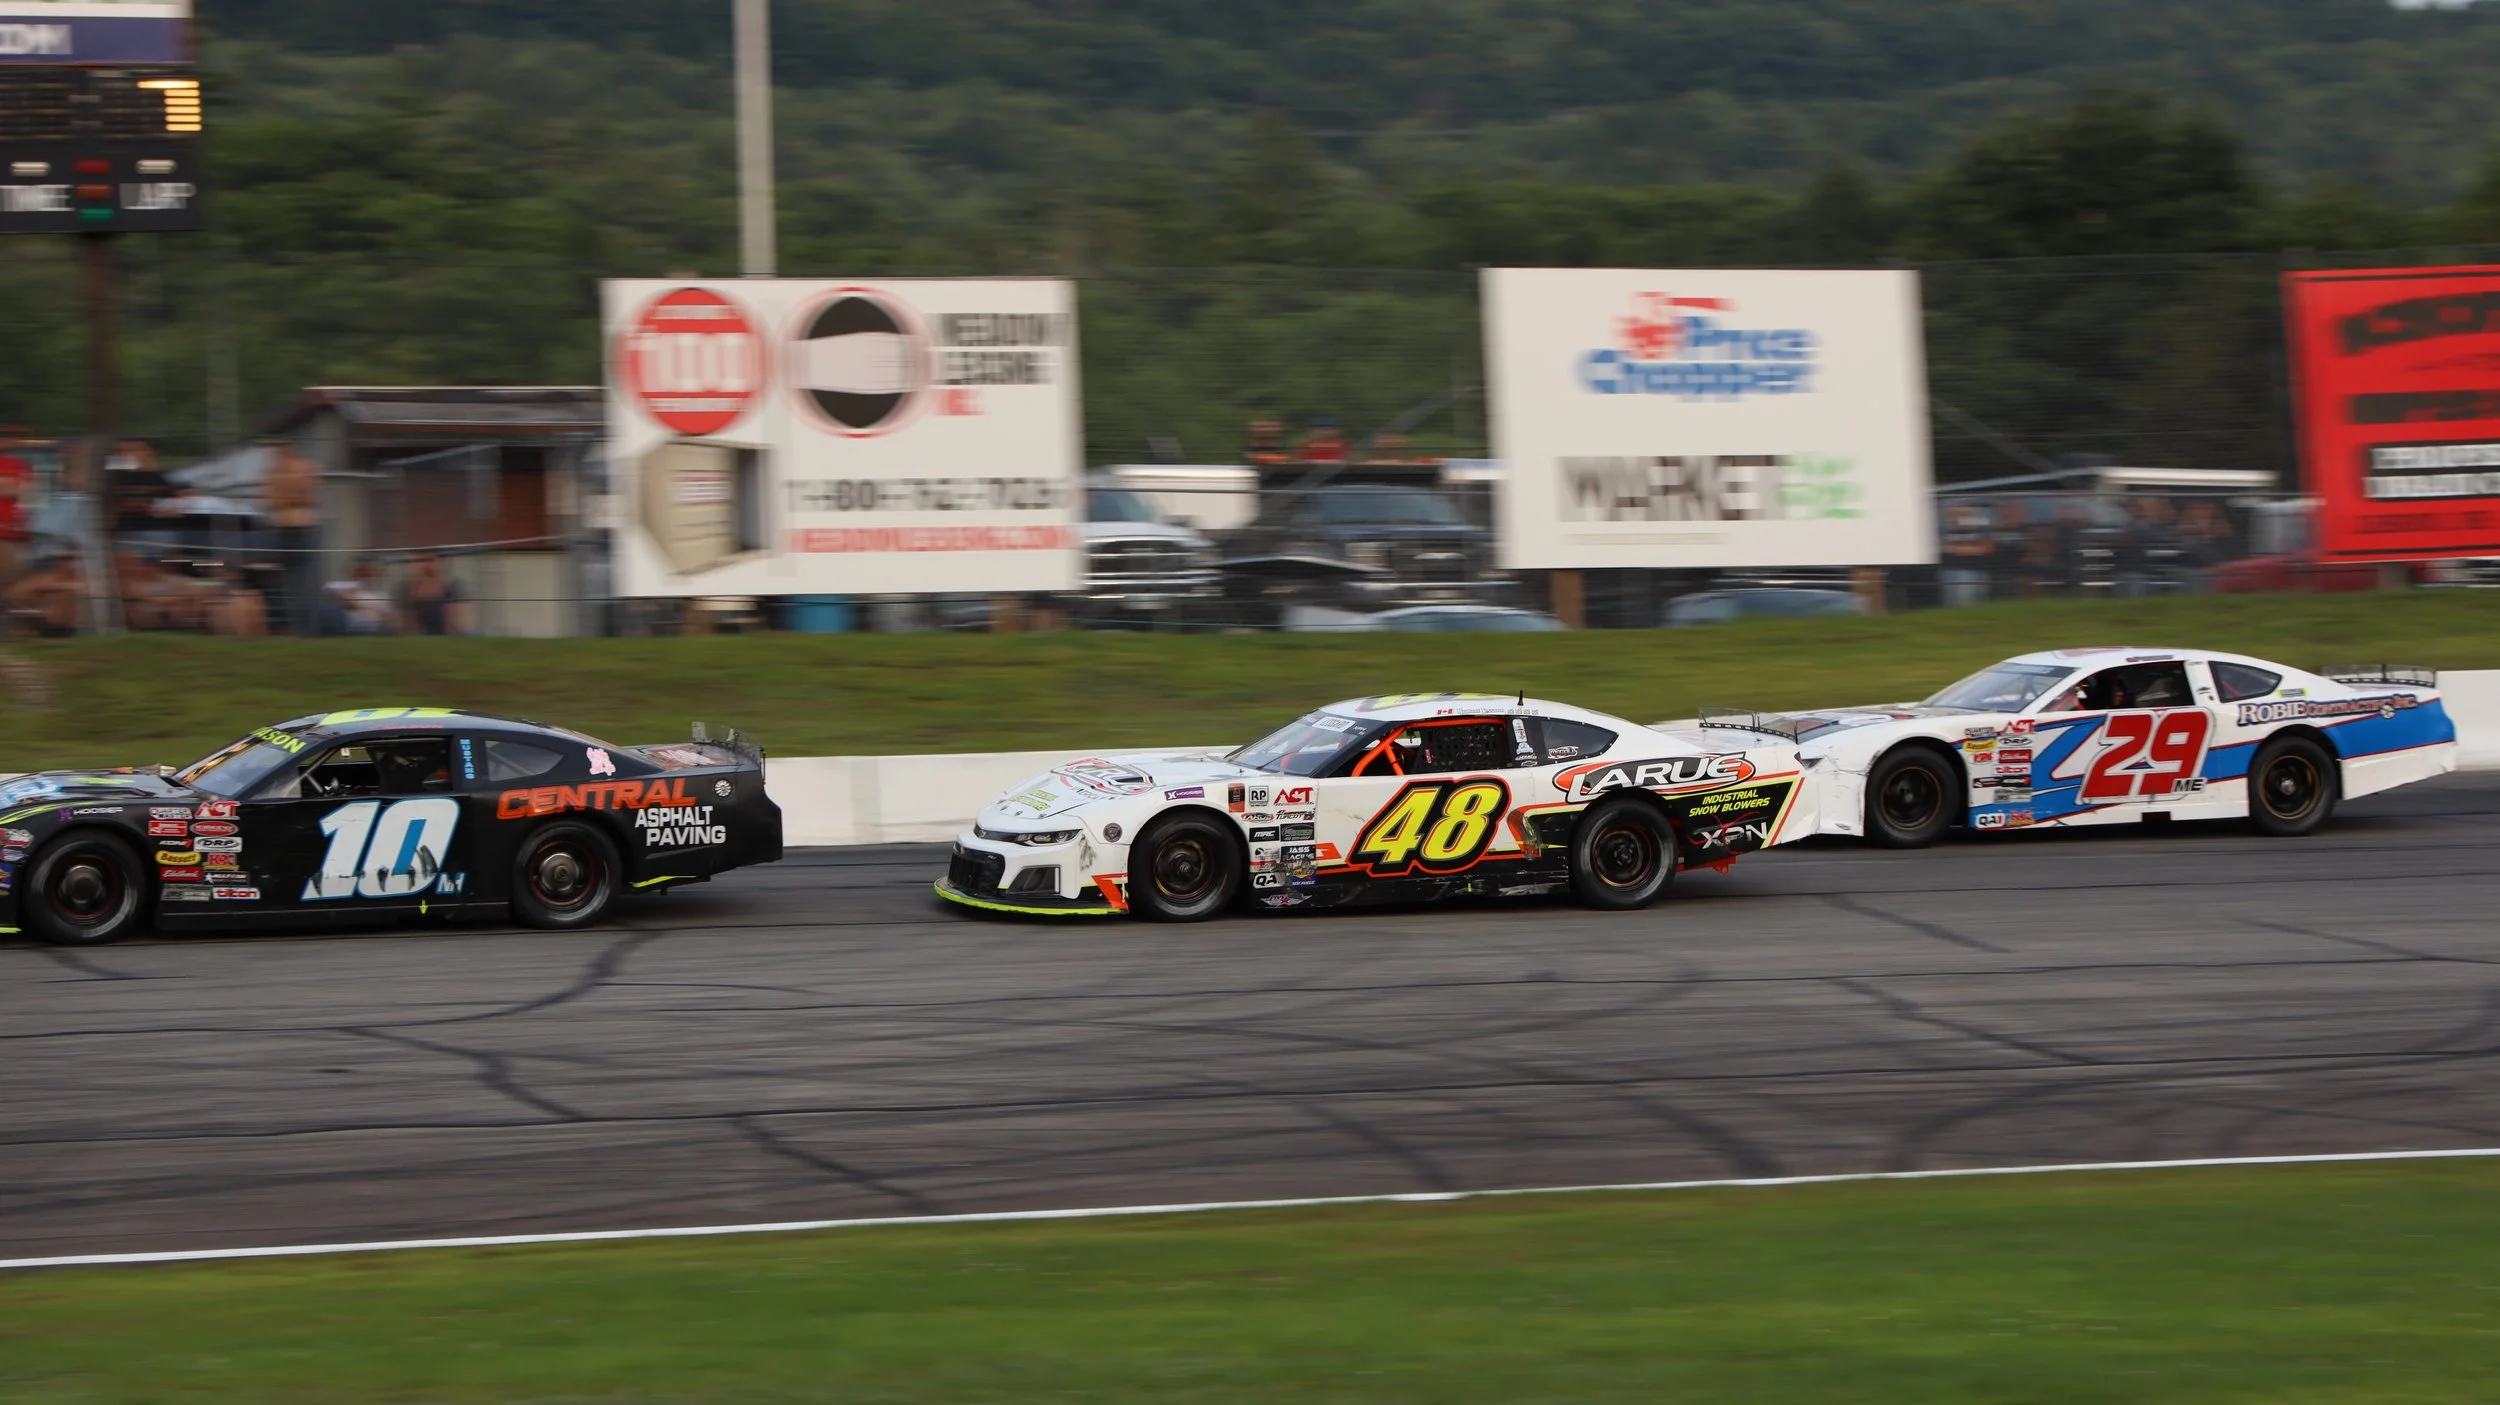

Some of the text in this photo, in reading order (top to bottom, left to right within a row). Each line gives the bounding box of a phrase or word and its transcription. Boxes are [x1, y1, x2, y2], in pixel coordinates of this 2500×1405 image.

[1557, 455, 1788, 521] MARKET
[2237, 701, 2306, 726] ROBIE
[2081, 711, 2207, 798] 29
[1566, 752, 1746, 803] LARUE
[2174, 779, 2204, 792] ME
[496, 778, 687, 820] CENTRAL
[1251, 790, 1267, 801] RP
[1273, 787, 1313, 804] ACT
[1702, 789, 1760, 806] INDUSTRIAL
[635, 806, 714, 828] ASPHALT
[1689, 797, 1771, 817] SNOW BLOWERS
[1357, 783, 1504, 865] 48
[1979, 815, 2003, 826] QA1
[203, 838, 235, 847] DRP
[646, 825, 727, 846] PAVING
[1254, 830, 1276, 838] MAC
[301, 797, 459, 900] 10
[216, 889, 257, 898] tilton
